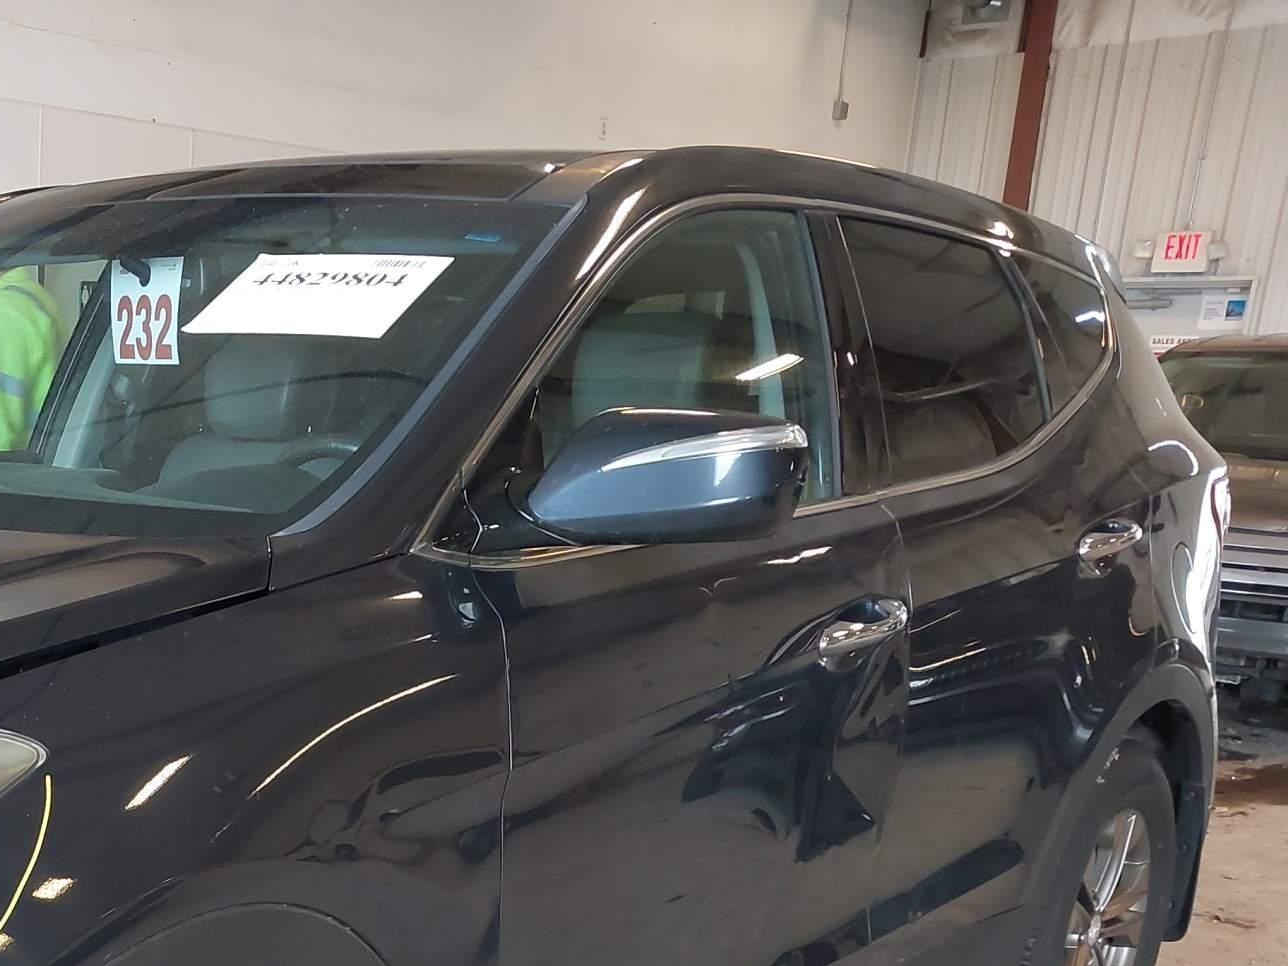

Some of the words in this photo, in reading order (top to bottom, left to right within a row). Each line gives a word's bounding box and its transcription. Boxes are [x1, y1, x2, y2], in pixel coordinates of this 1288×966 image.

[1164, 234, 1203, 260] EXIT
[252, 272, 409, 287] 44829804
[116, 293, 173, 360] 232
[1152, 337, 1175, 345] SALES
